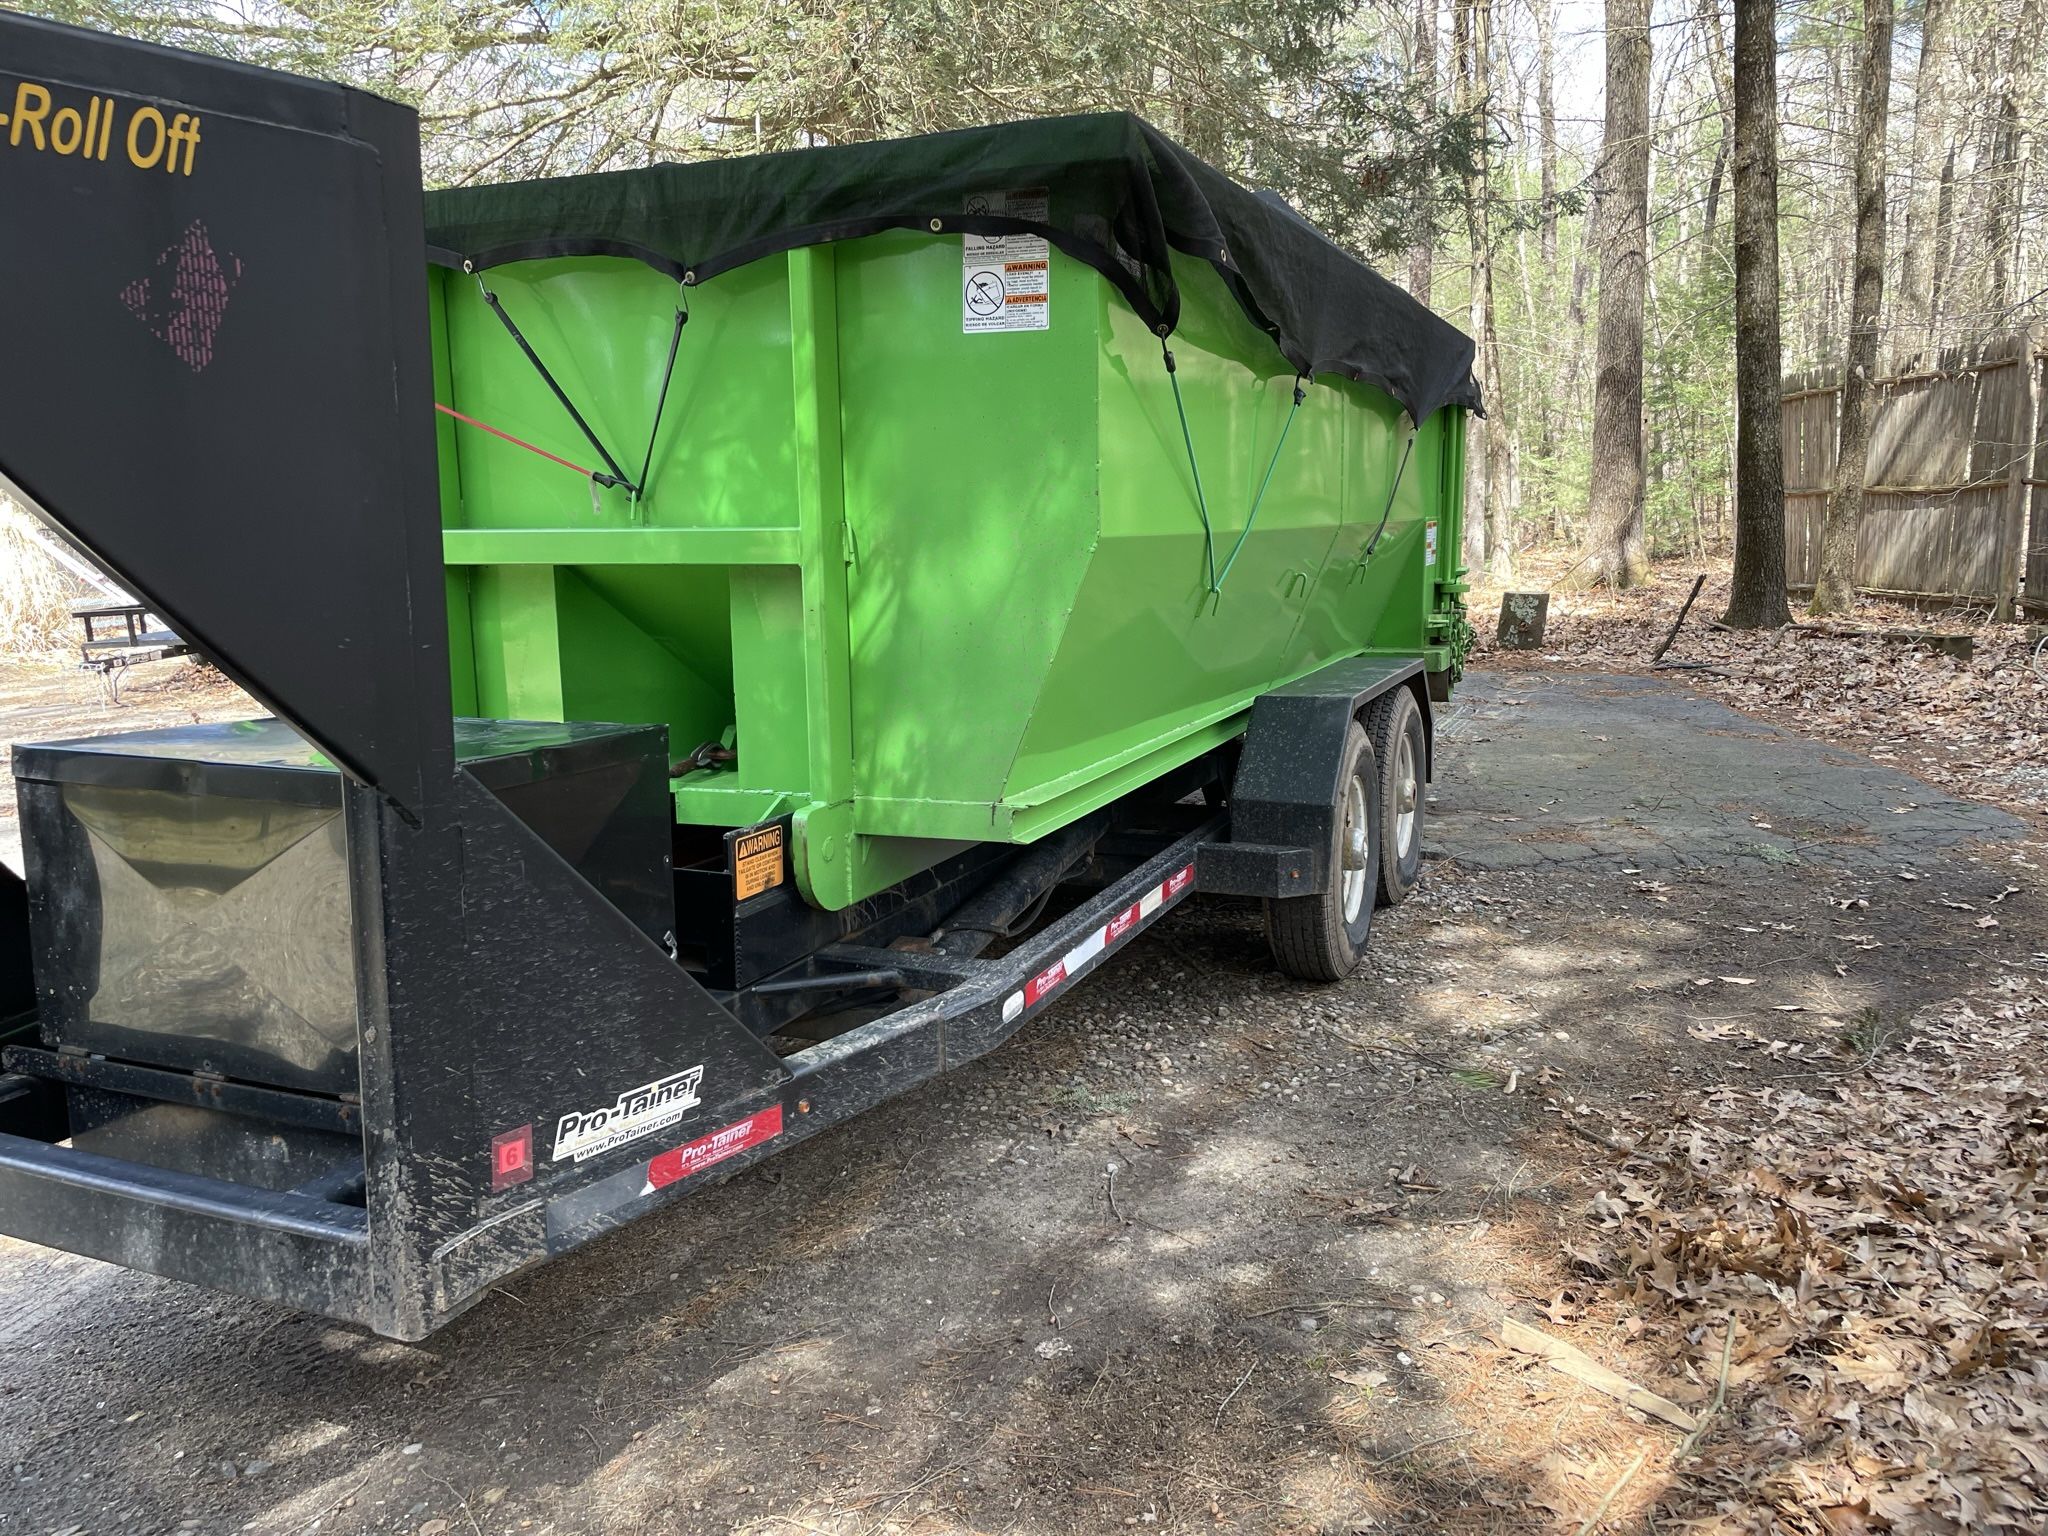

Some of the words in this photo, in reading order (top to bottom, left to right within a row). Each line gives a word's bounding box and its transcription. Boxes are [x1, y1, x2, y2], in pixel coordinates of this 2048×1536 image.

[127, 106, 201, 176] Off
[1012, 262, 1046, 271] WARNING
[1012, 295, 1047, 304] ADVERTENCIA
[746, 829, 780, 856] WARNING
[558, 1069, 702, 1144] Pro-Tainer
[576, 1112, 682, 1160] www.ProTainer.com
[681, 1120, 754, 1164] Pro-Tainer
[506, 1147, 518, 1166] 6
